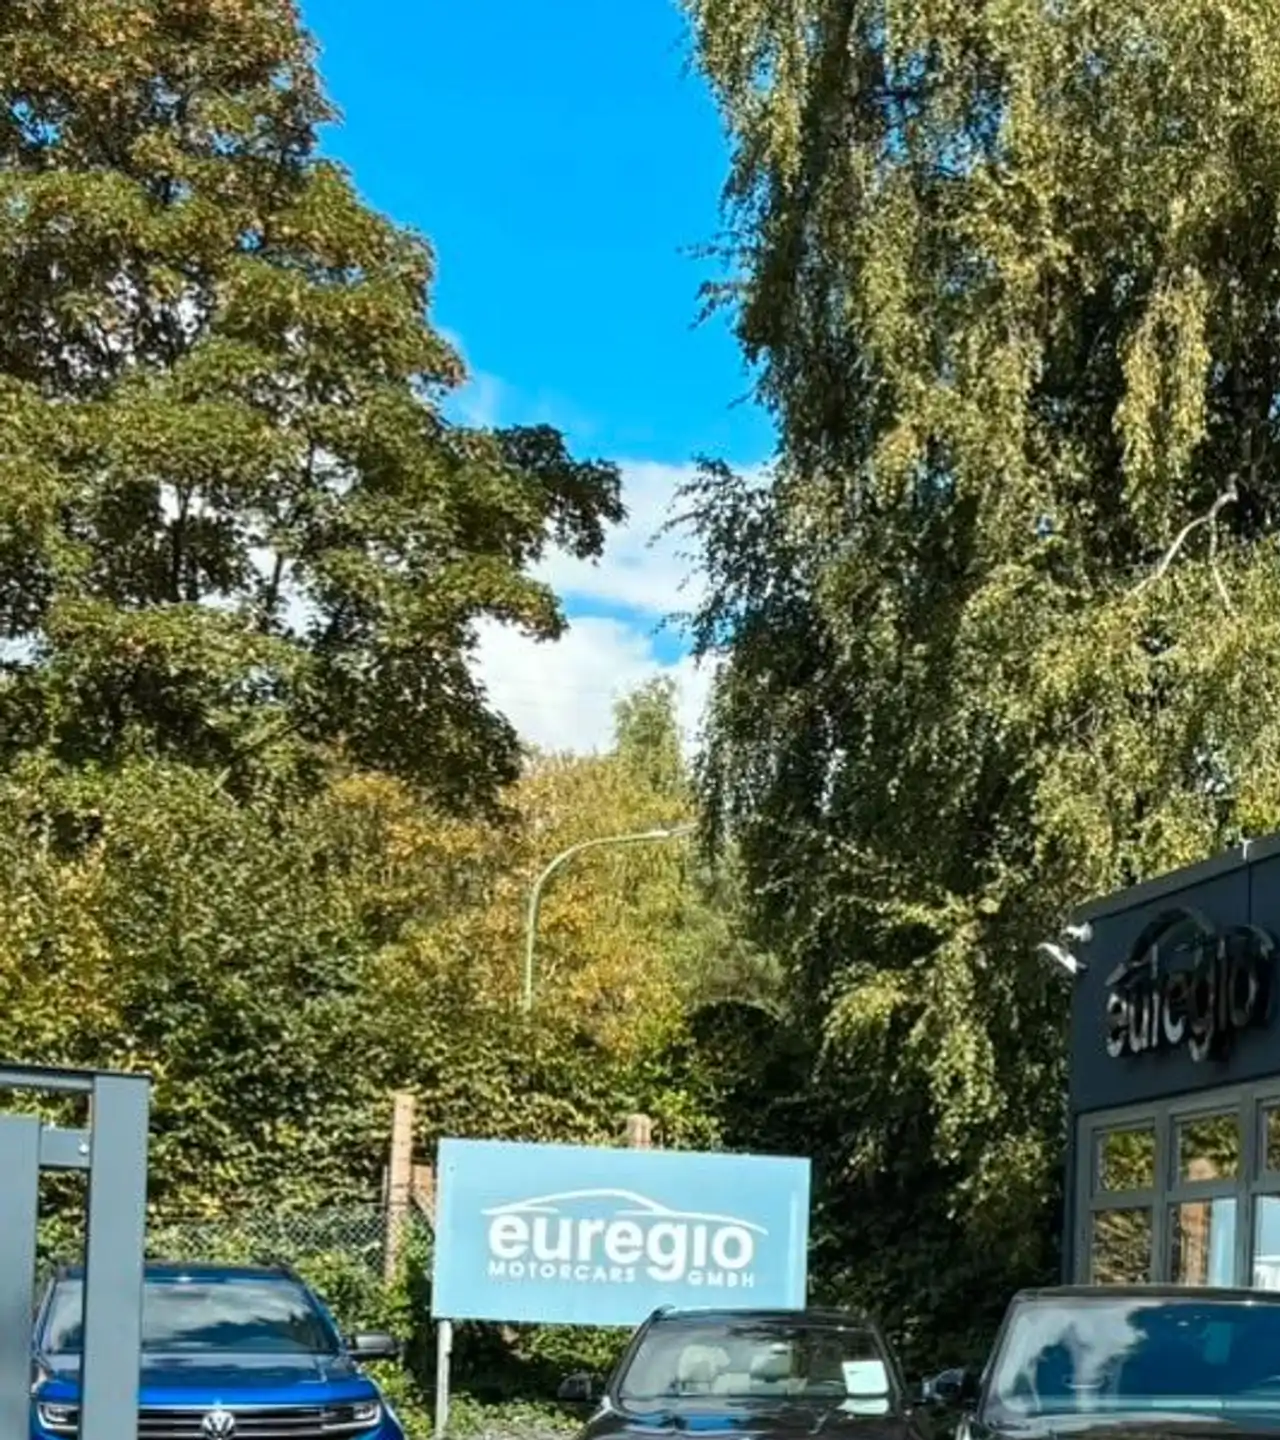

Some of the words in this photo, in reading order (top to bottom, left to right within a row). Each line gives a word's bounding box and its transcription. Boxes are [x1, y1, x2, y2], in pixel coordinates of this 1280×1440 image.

[488, 1213, 754, 1282] euregio
[488, 1261, 636, 1283] MOTORCARS
[687, 1270, 755, 1288] GMBH
